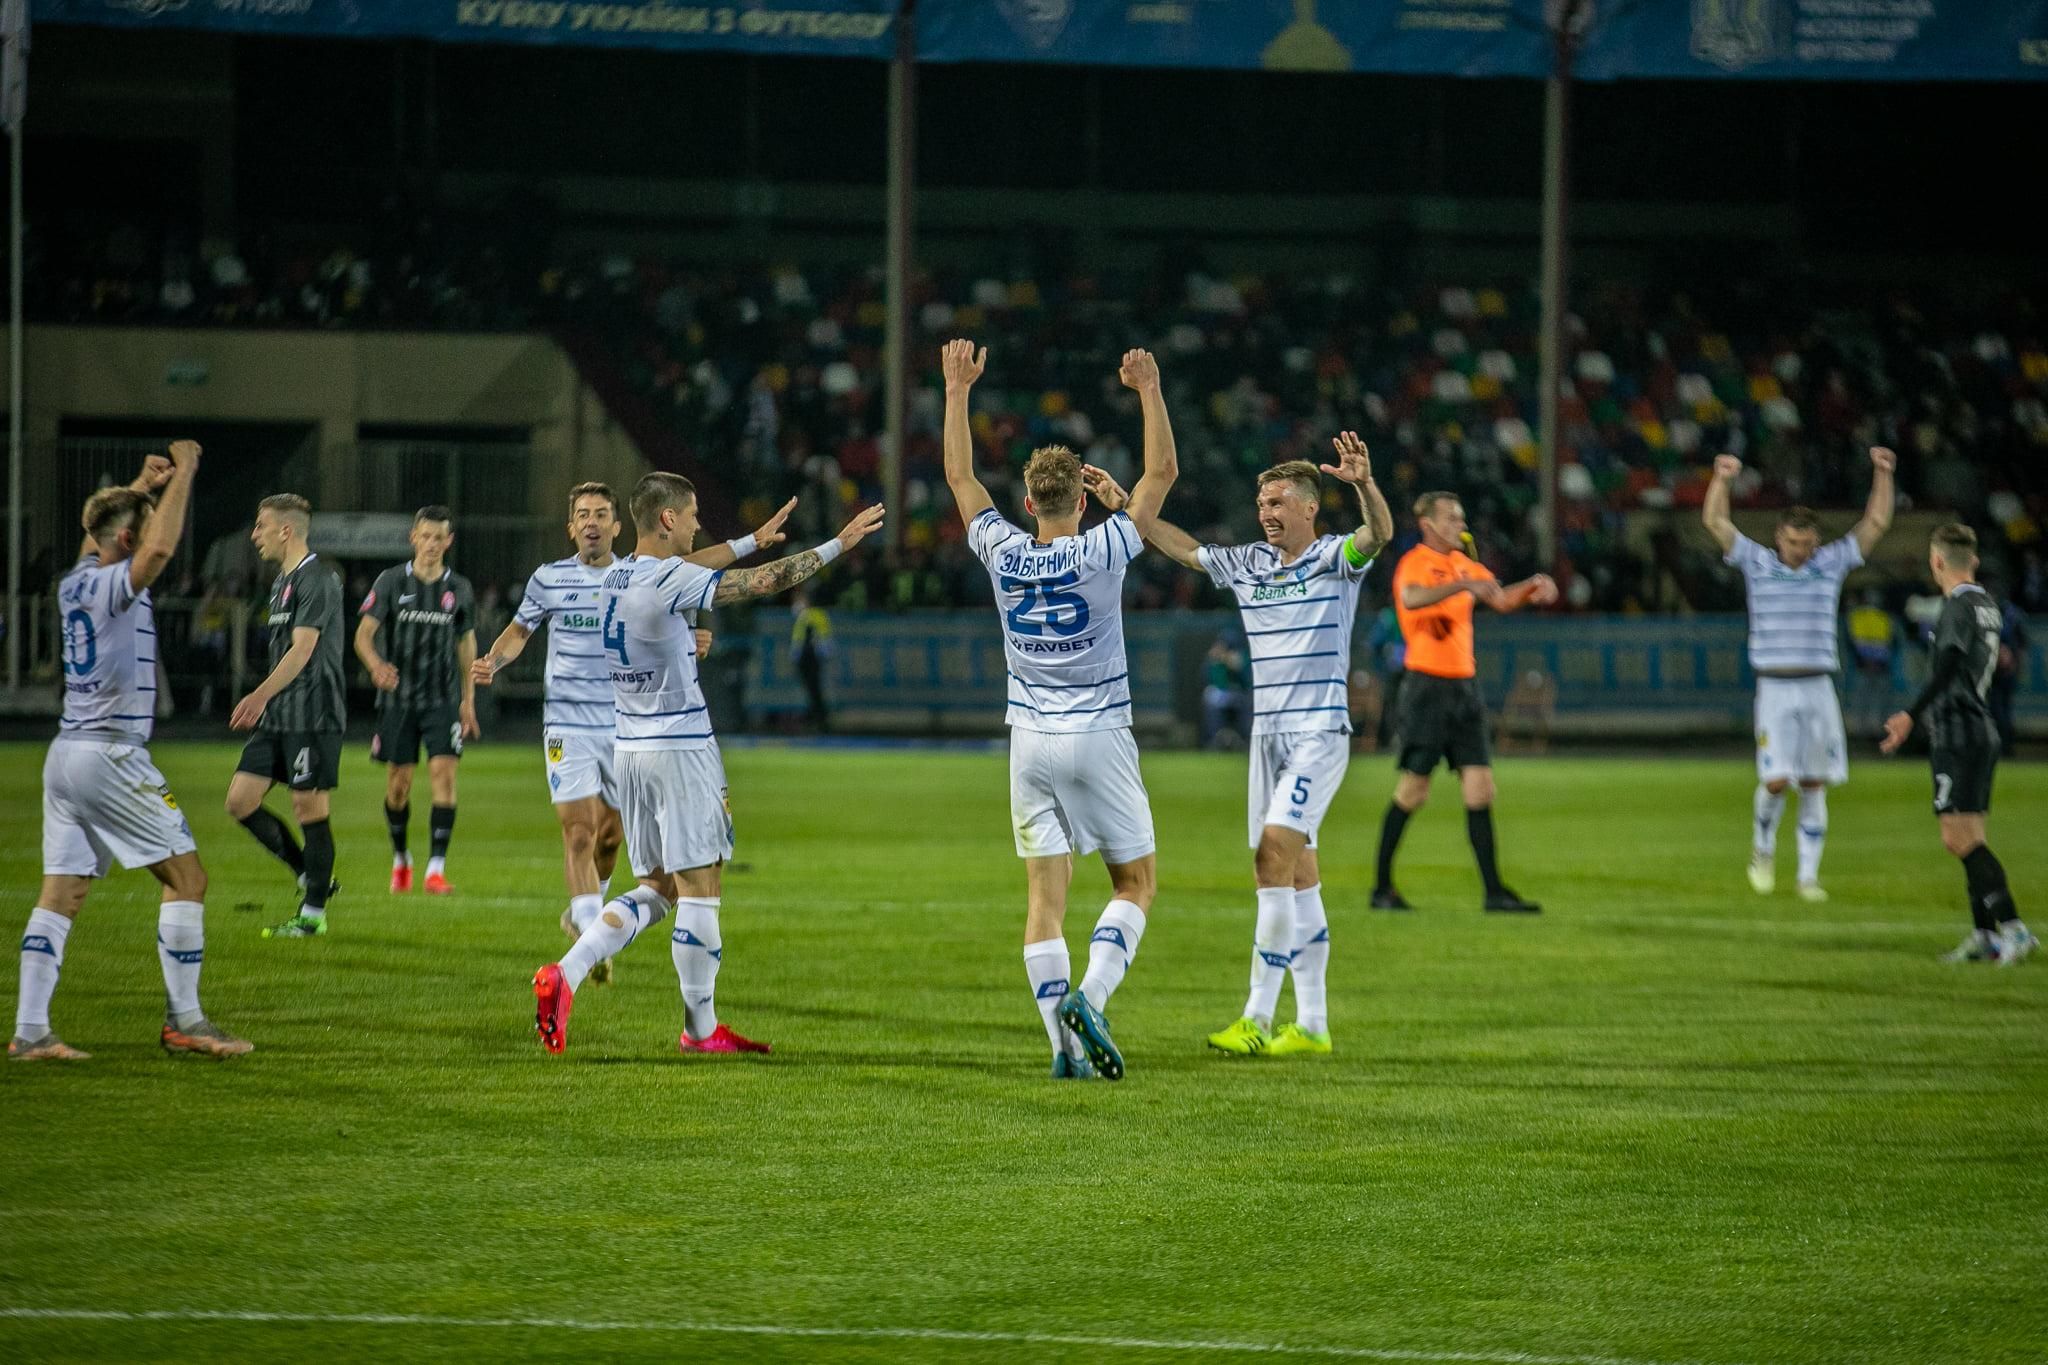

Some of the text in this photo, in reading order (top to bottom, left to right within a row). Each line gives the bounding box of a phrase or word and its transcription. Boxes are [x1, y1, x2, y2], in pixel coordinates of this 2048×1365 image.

[1000, 570, 1090, 636] 25
[603, 596, 631, 666] 4
[1024, 636, 1096, 653] FAVBET
[293, 746, 310, 774] 4
[1291, 775, 1312, 805] 5
